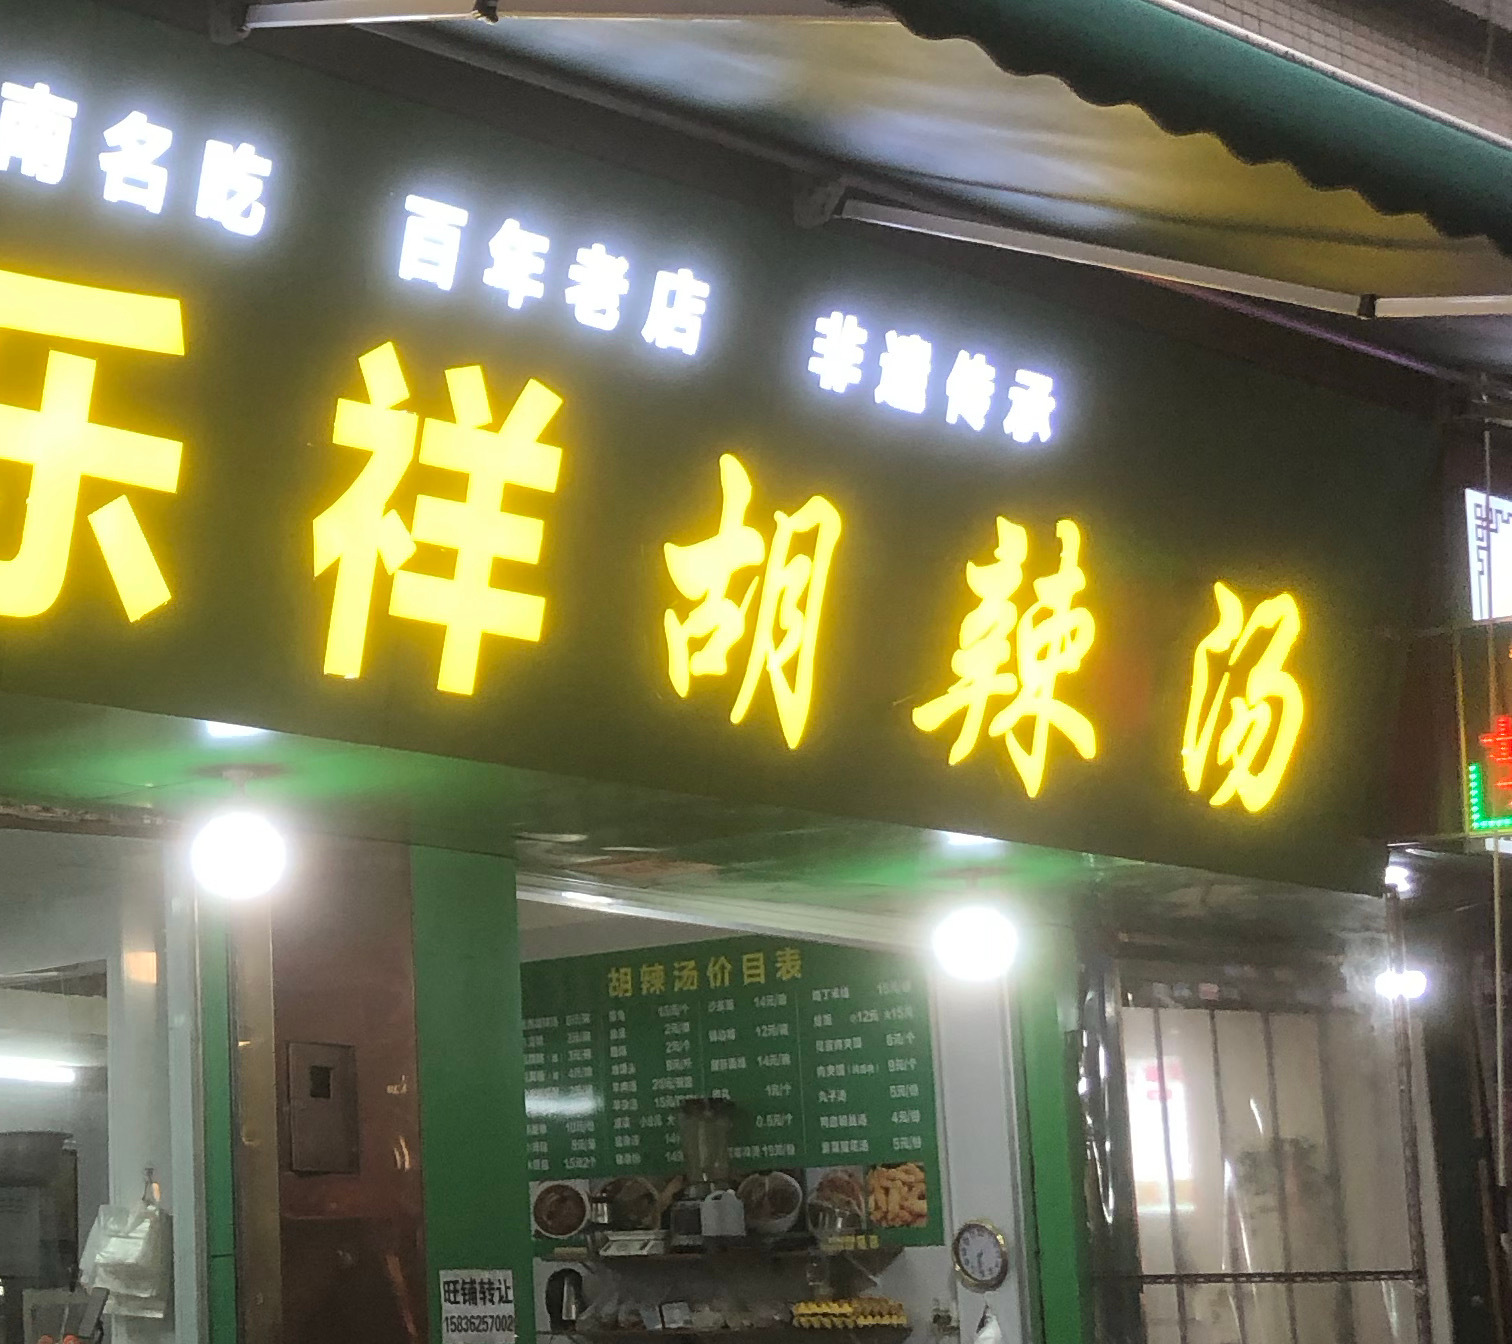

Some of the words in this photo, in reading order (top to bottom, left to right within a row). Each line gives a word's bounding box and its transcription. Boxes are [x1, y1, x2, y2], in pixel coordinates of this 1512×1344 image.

[397, 193, 710, 356] 百年老店
[608, 948, 802, 997] 胡辣汤价目表
[443, 1277, 513, 1306] 旺铺转让
[445, 1314, 514, 1333] 15836257002
